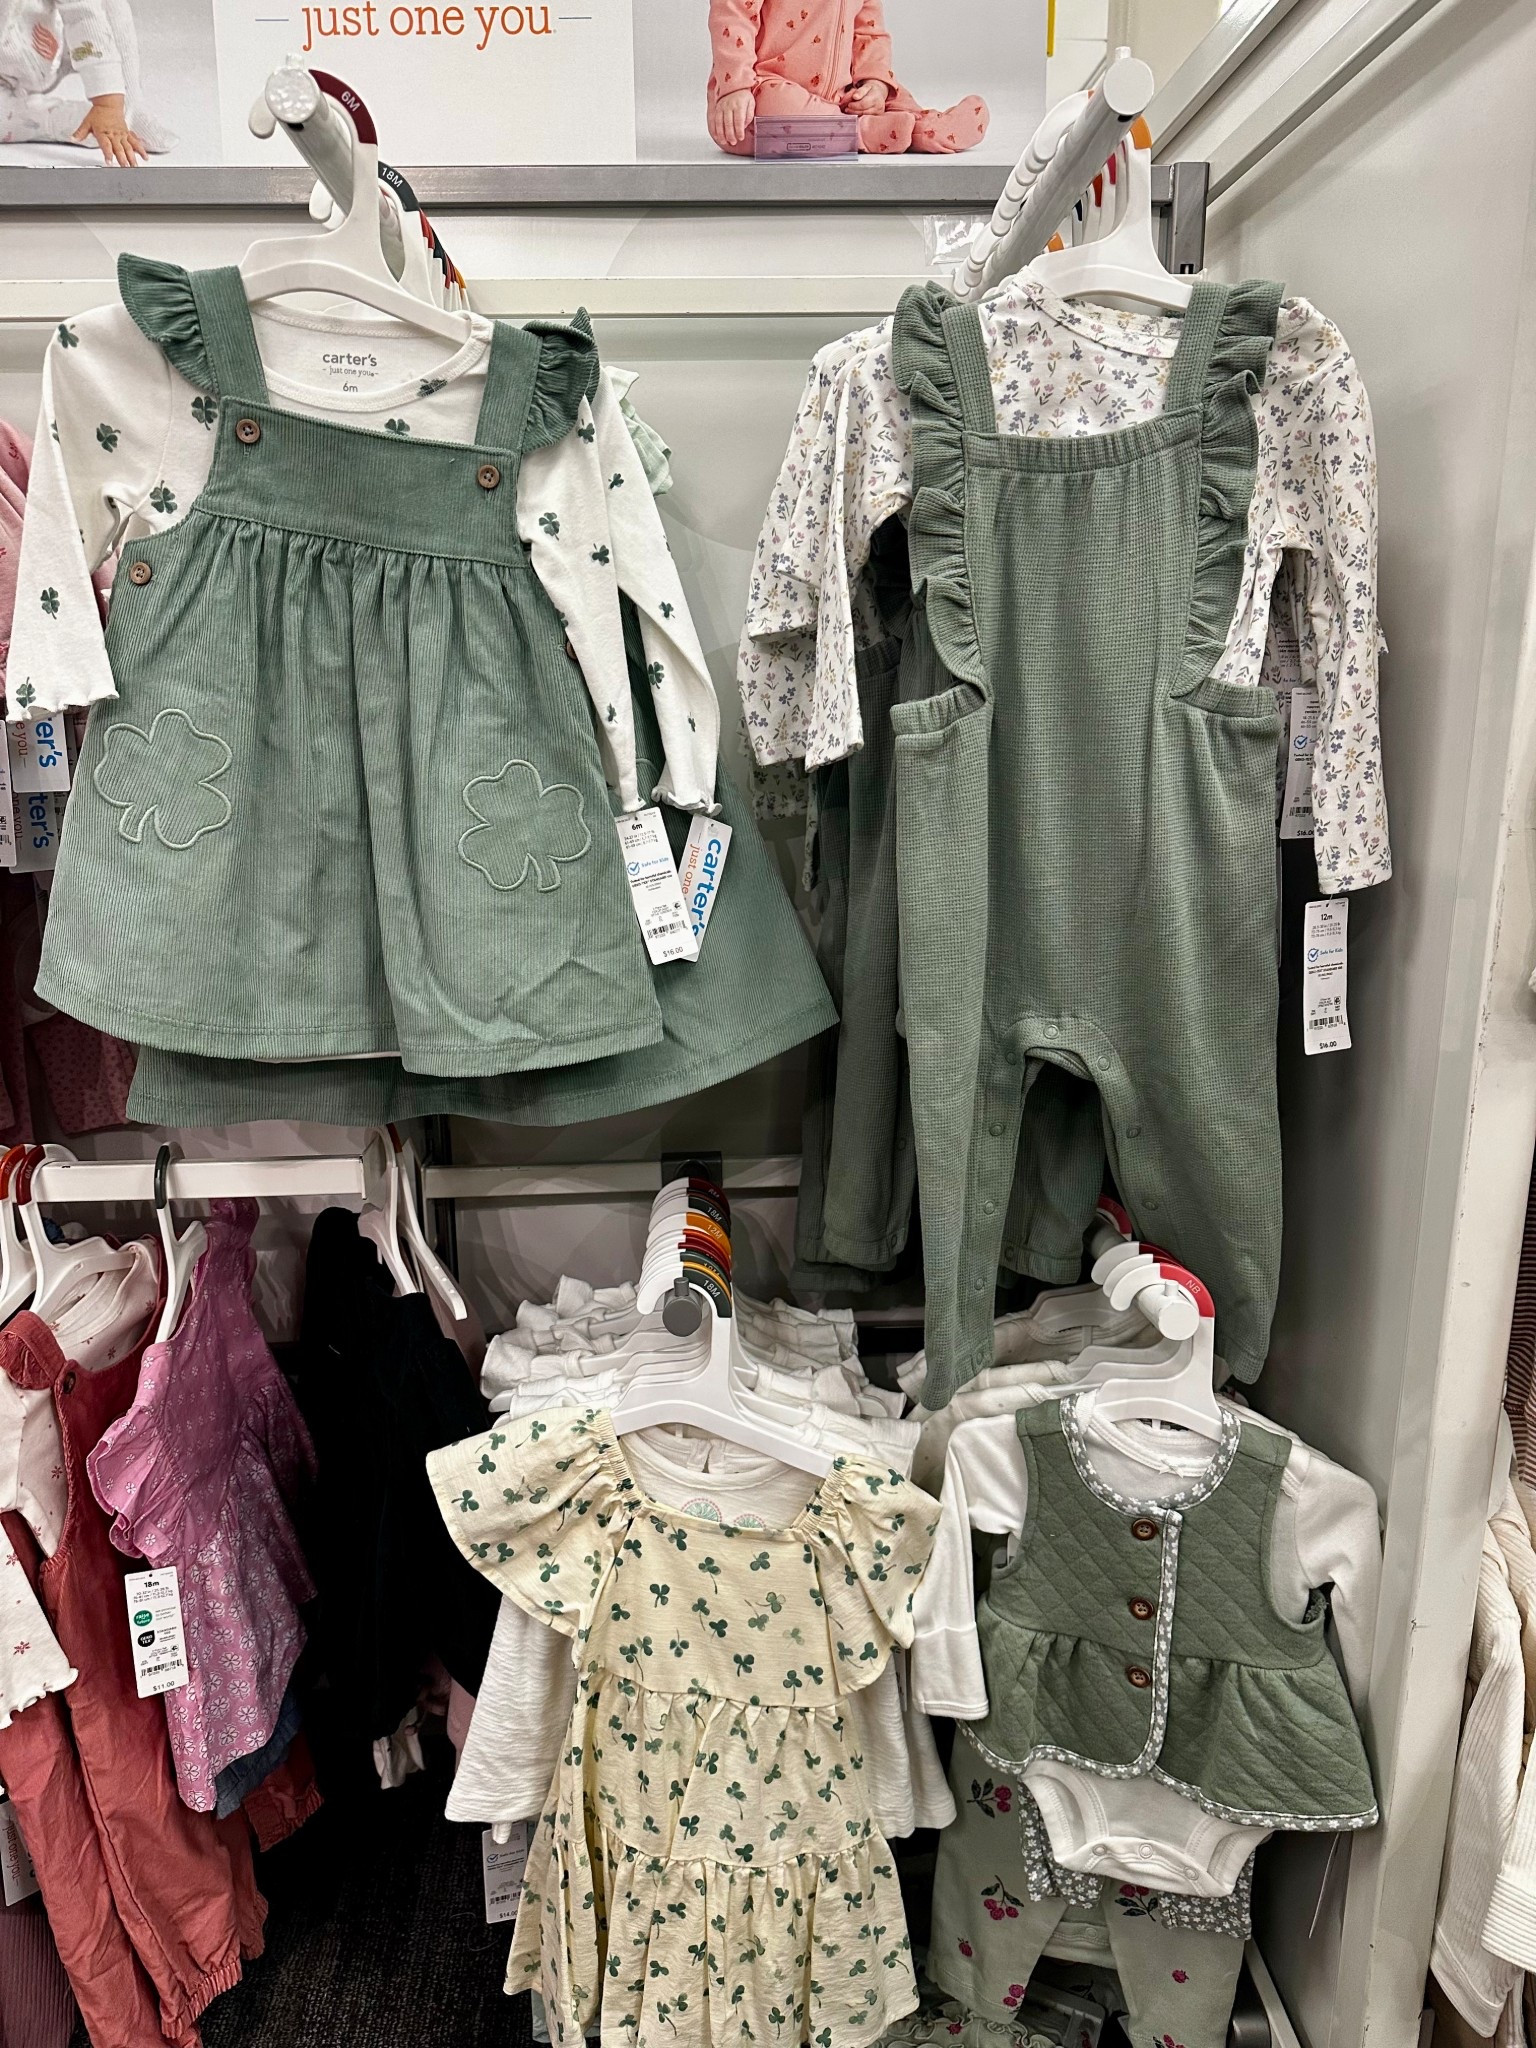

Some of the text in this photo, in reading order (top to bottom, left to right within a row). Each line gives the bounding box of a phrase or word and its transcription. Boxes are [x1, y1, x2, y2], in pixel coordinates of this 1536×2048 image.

[301, 0, 553, 52] just one you
[340, 90, 361, 113] 6M
[380, 166, 404, 189] 18M
[322, 353, 378, 367] carter's
[329, 365, 343, 376] just
[342, 382, 359, 393] 6m
[12, 732, 28, 758] you
[34, 717, 63, 769] er's
[28, 792, 55, 849] ter's
[631, 823, 643, 831] 6m
[681, 843, 702, 895] just one
[1320, 913, 1333, 921] 12m
[662, 946, 684, 958] $16.00
[1319, 1040, 1338, 1050] $16.00
[706, 1206, 723, 1222] 18M
[706, 1224, 724, 1241] 12M
[702, 1279, 722, 1299] 18M
[1185, 1279, 1202, 1295] NB
[152, 1680, 174, 1691] $11.00
